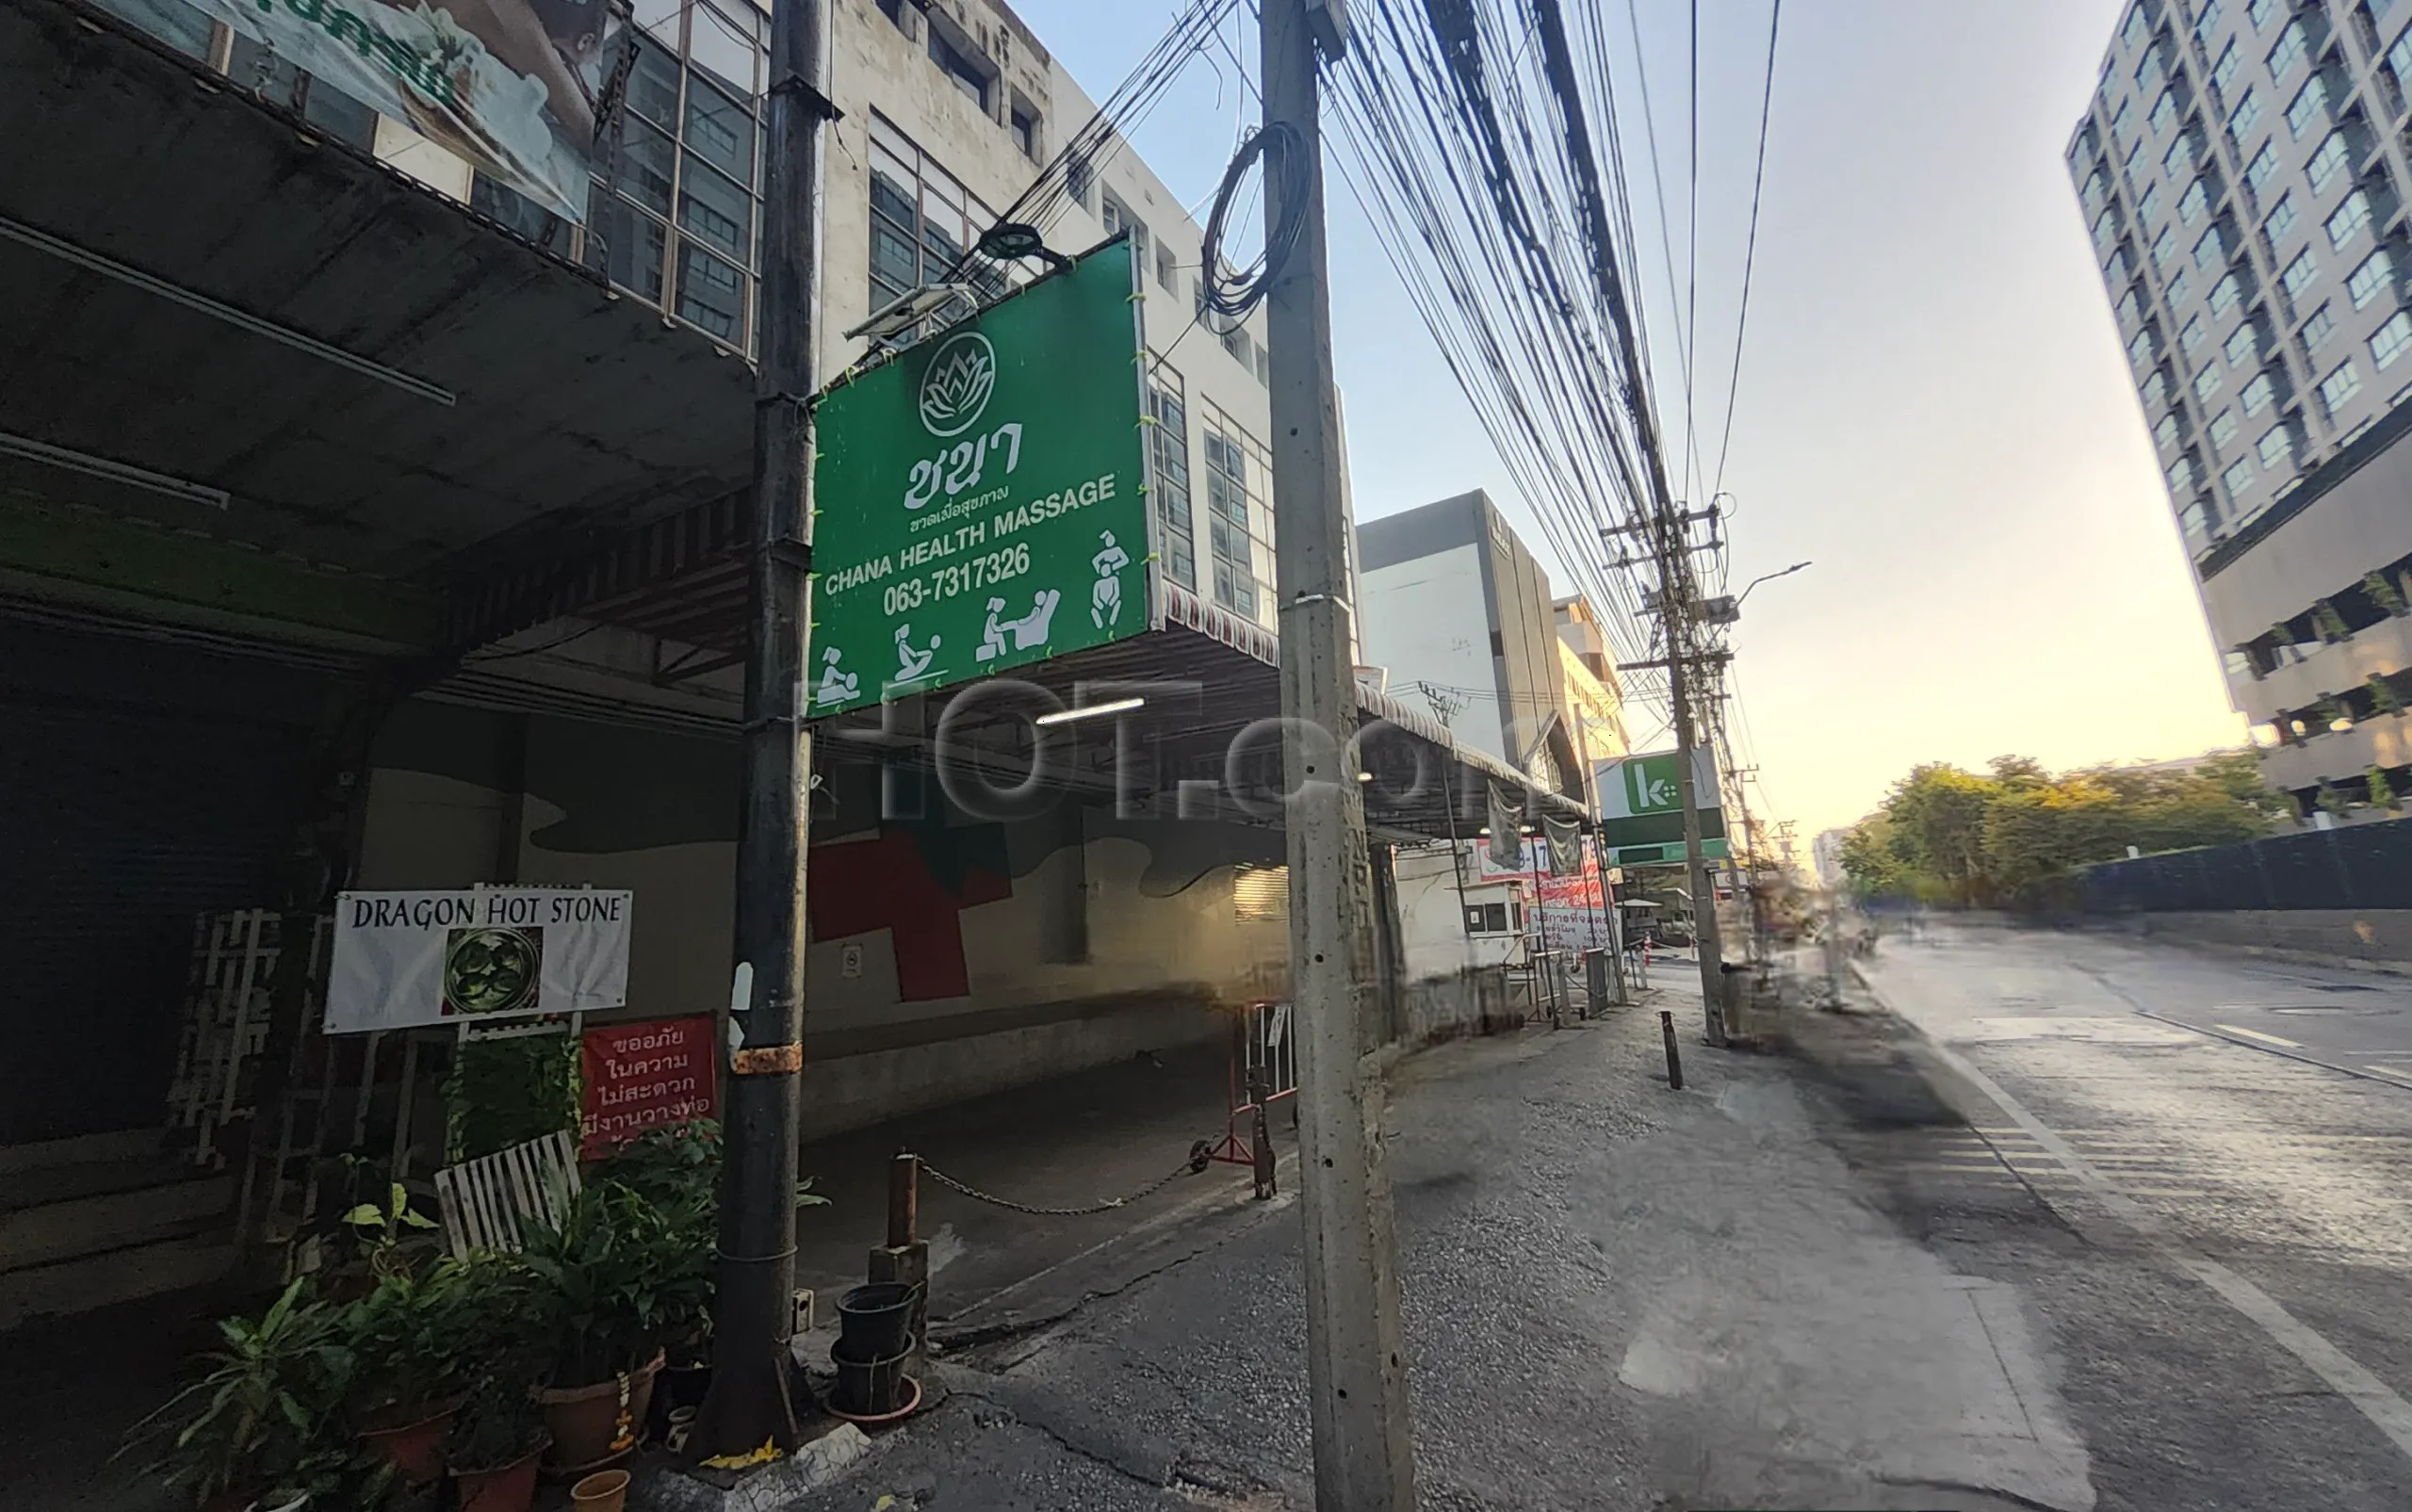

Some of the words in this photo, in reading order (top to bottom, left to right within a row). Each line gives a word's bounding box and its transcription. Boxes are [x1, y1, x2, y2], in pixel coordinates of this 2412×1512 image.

[825, 556, 893, 597] CHANA
[900, 521, 986, 569] HEALTH
[994, 473, 1116, 536] MASSAGE
[883, 543, 1031, 617] 063-7317326
[352, 898, 476, 931] DRAGON
[488, 897, 541, 925] HOT
[550, 896, 622, 924] STONE
[613, 1026, 684, 1054] ขออภัย
[606, 1053, 688, 1080] ในความ
[597, 1076, 695, 1107] ไม่สะดวก
